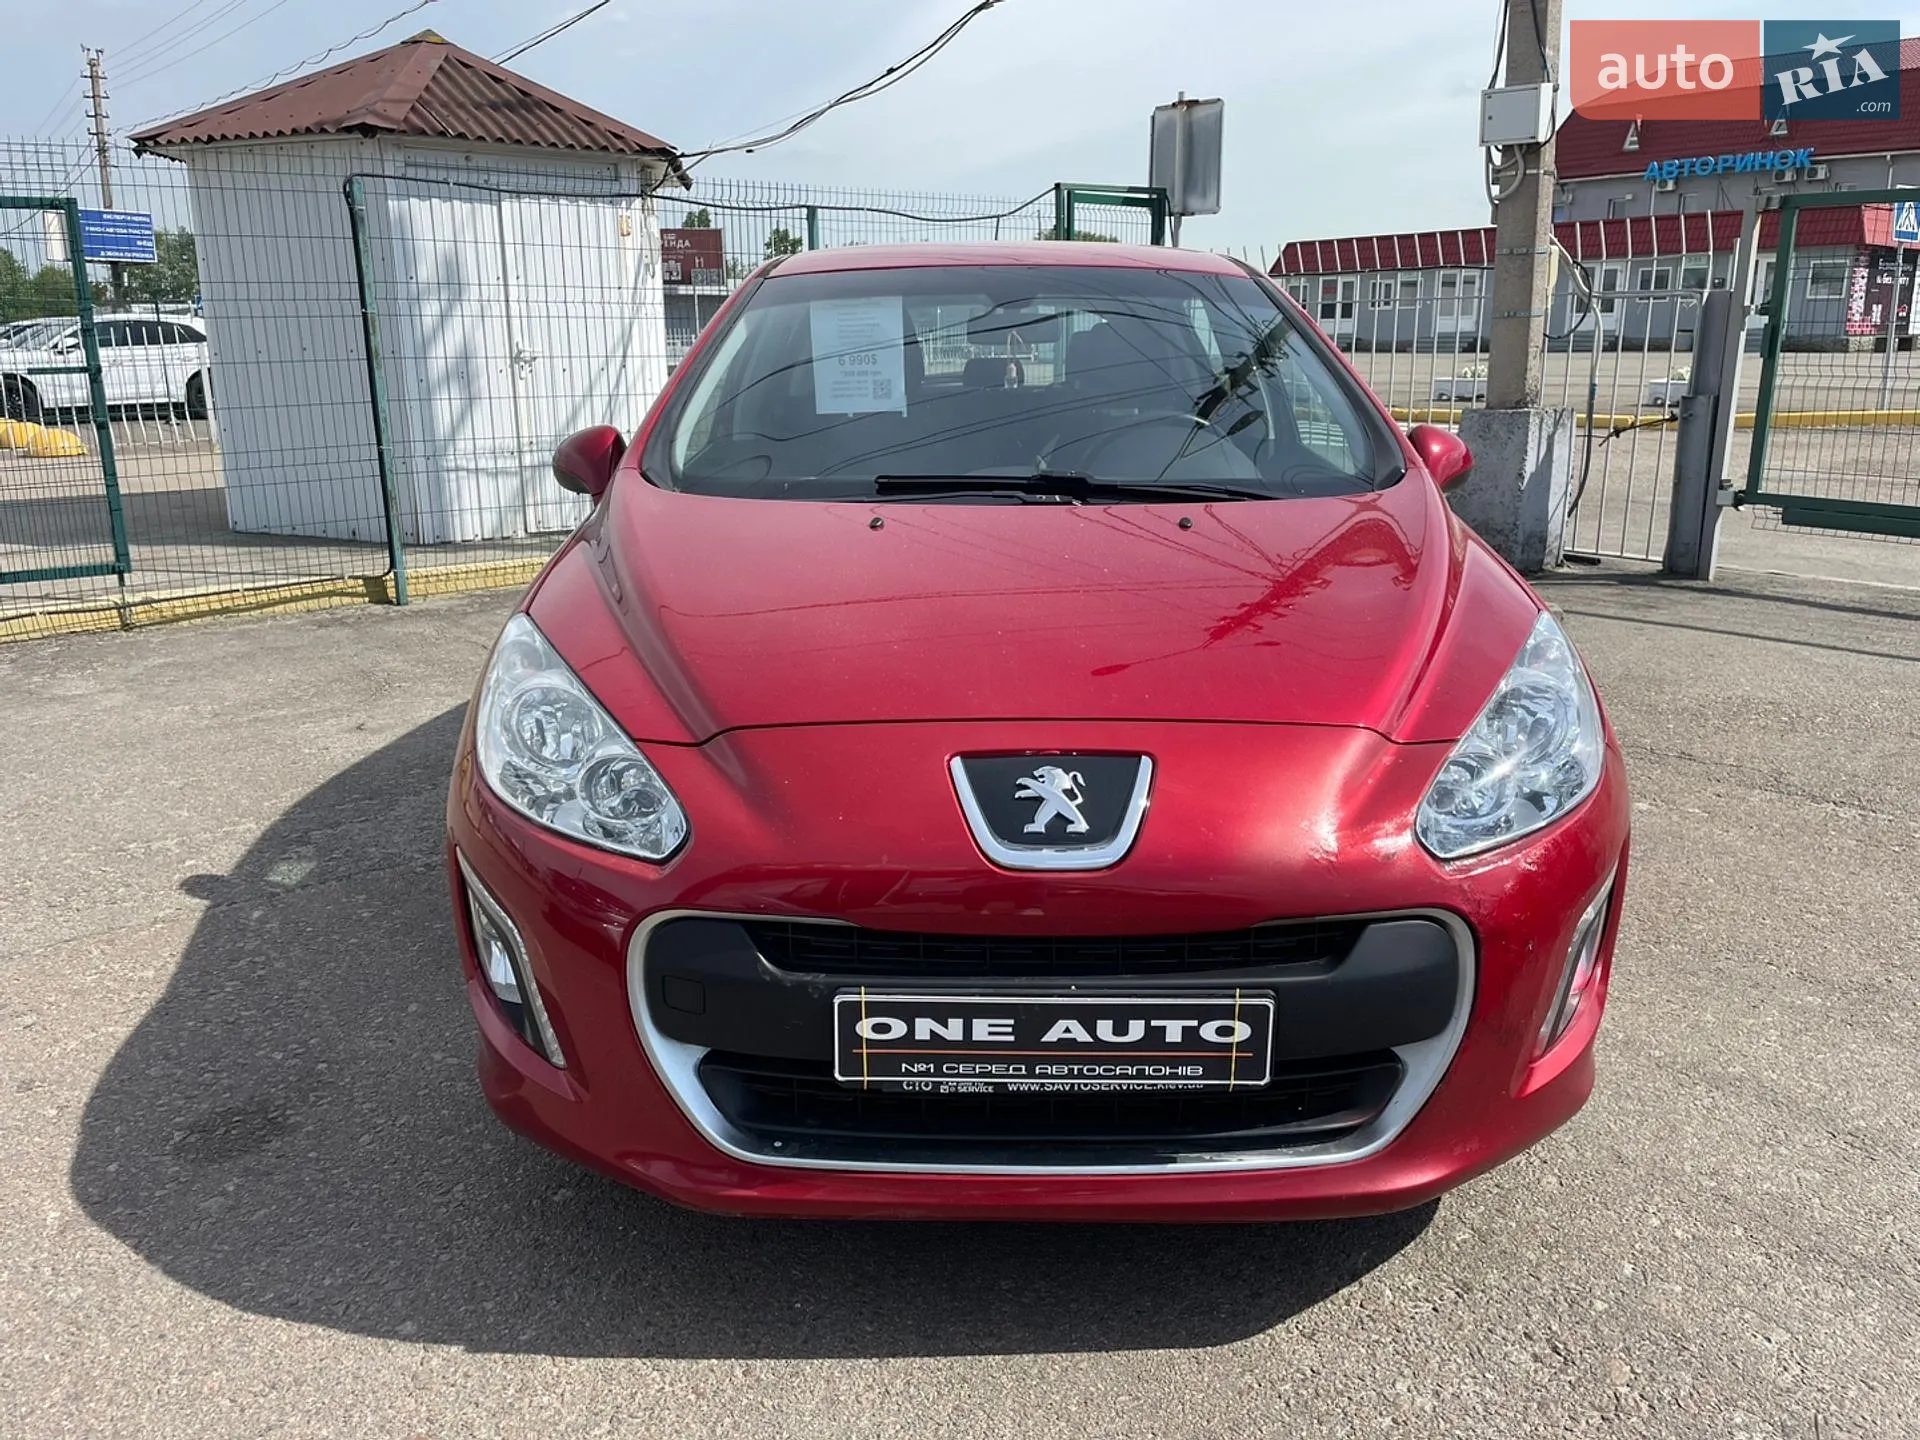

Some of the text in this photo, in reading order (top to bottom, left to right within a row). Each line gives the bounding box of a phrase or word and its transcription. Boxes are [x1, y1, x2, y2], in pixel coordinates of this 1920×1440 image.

[1644, 147, 1815, 181] АВТОРИНОК
[855, 1017, 1252, 1043] ONE AUTO
[901, 1063, 1204, 1076] №1 СЕРЕД АВТОСАЛОНІВ
